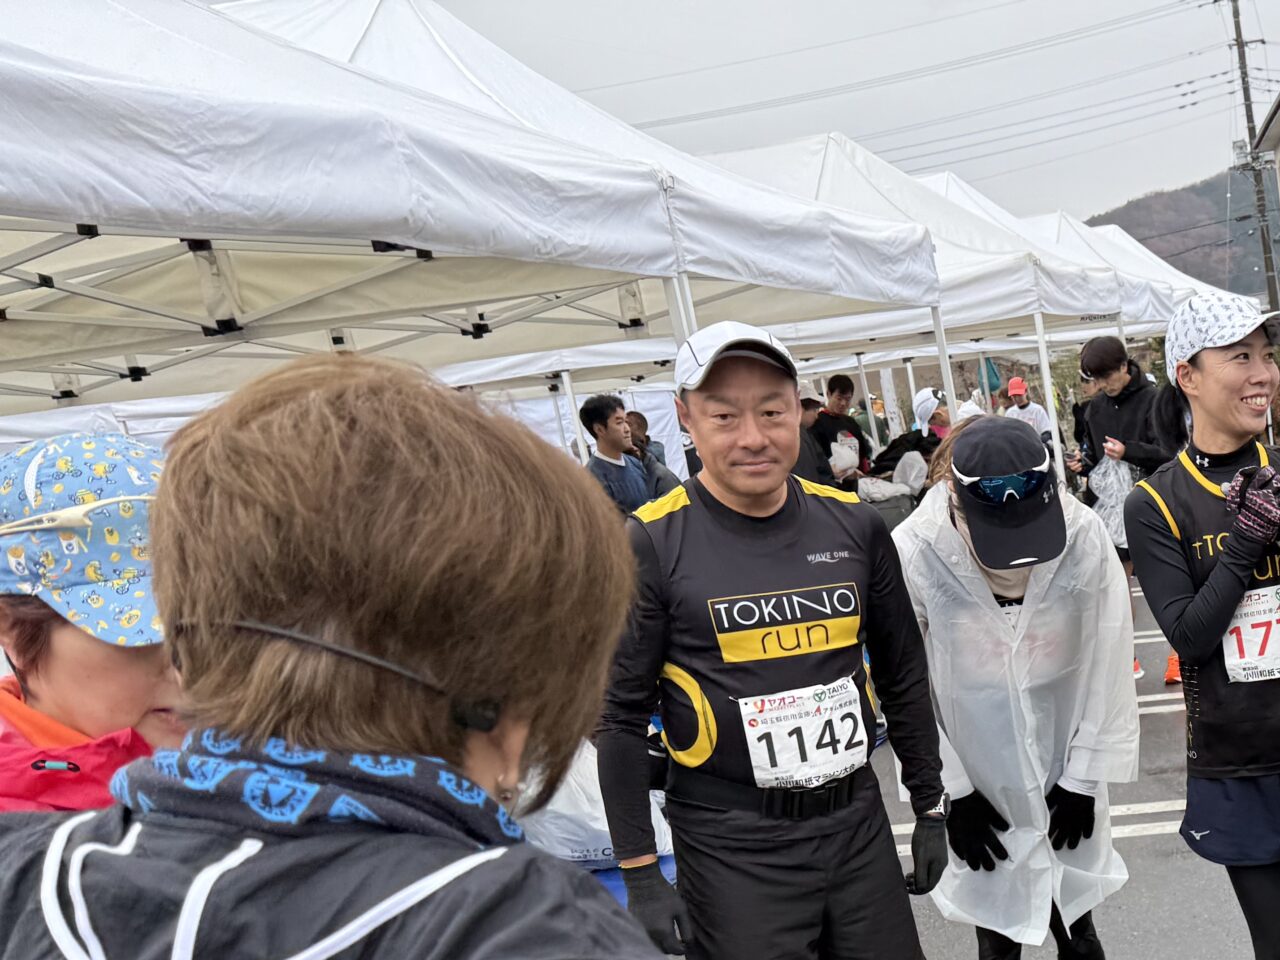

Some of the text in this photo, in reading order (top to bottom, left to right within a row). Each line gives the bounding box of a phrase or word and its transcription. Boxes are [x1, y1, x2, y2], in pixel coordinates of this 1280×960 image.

[806, 550, 849, 562] WAVE ONE
[714, 588, 856, 629] TOKINO
[761, 623, 829, 653] run
[827, 682, 849, 695] TAIYO
[768, 695, 805, 708] ヤオコー
[756, 712, 864, 769] 1142
